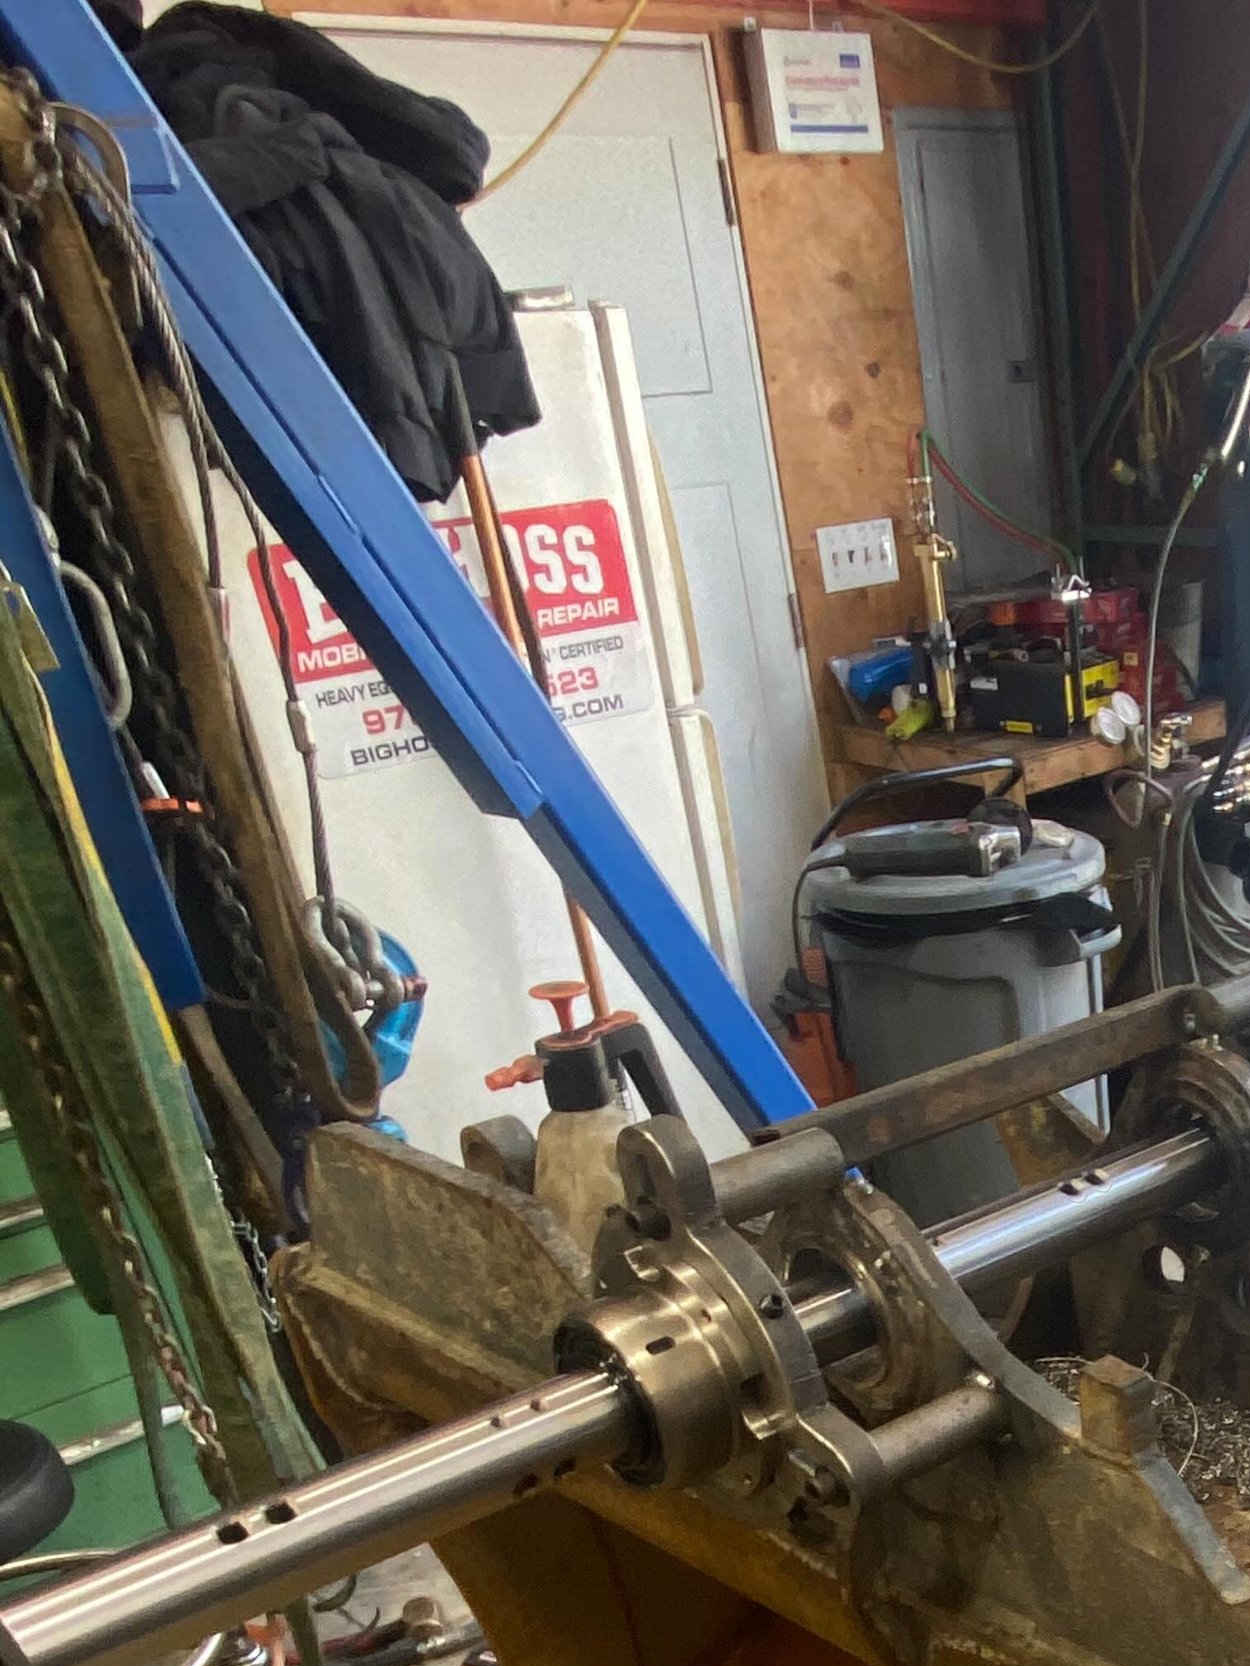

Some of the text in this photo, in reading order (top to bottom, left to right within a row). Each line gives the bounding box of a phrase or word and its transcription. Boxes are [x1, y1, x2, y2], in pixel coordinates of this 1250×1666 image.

[537, 597, 620, 629] REPAIR
[316, 683, 366, 708] HEAVY
[559, 635, 624, 660] CERTIFIED
[350, 736, 429, 766] BIGHO
